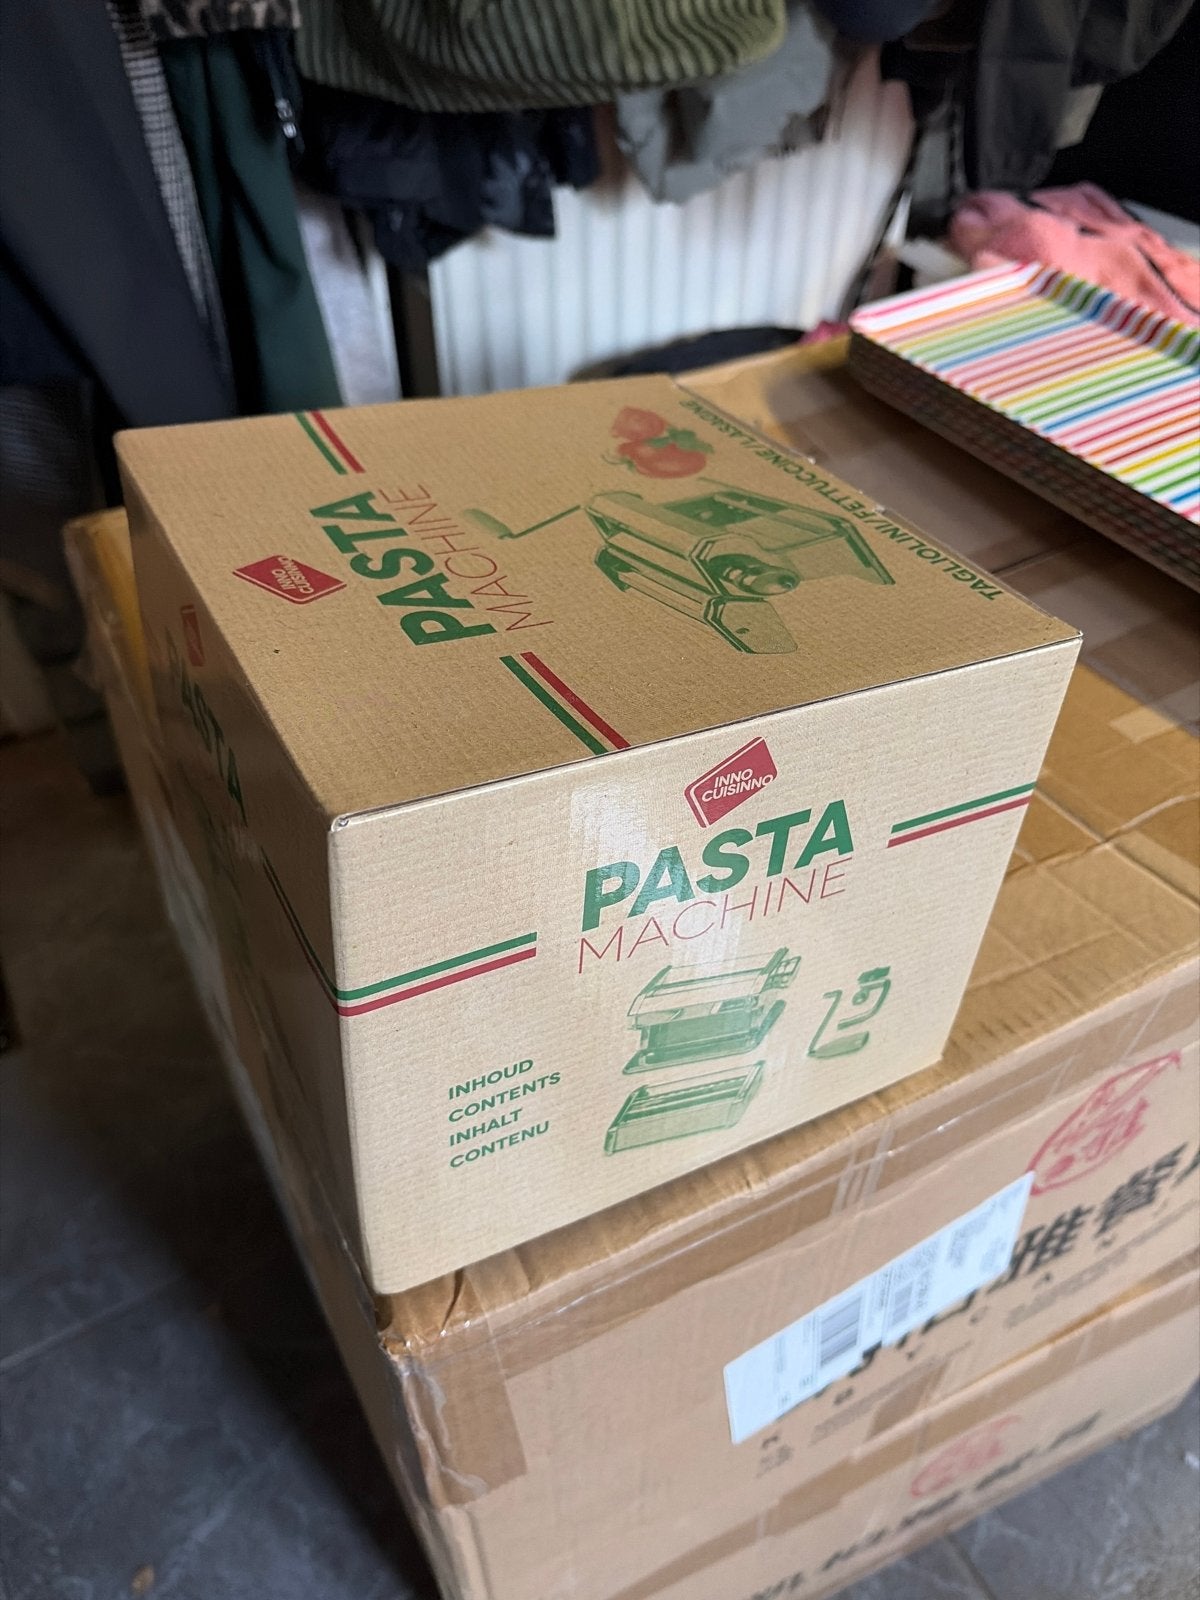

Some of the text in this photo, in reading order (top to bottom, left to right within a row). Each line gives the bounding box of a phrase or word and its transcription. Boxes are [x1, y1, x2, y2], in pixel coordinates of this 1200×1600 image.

[271, 568, 297, 590] INNO
[278, 556, 315, 594] CUISINNO
[309, 491, 498, 646] PASTA
[378, 484, 555, 632] MACHINE
[701, 774, 774, 803] CUISINNO
[714, 768, 754, 788] INNO
[581, 799, 854, 932] PASTA
[578, 856, 853, 974] MACHINE
[448, 1059, 534, 1100] INHOUD
[448, 1071, 561, 1123] CONTENTS
[449, 1107, 523, 1147] INHALT
[449, 1120, 550, 1168] CONTENU
